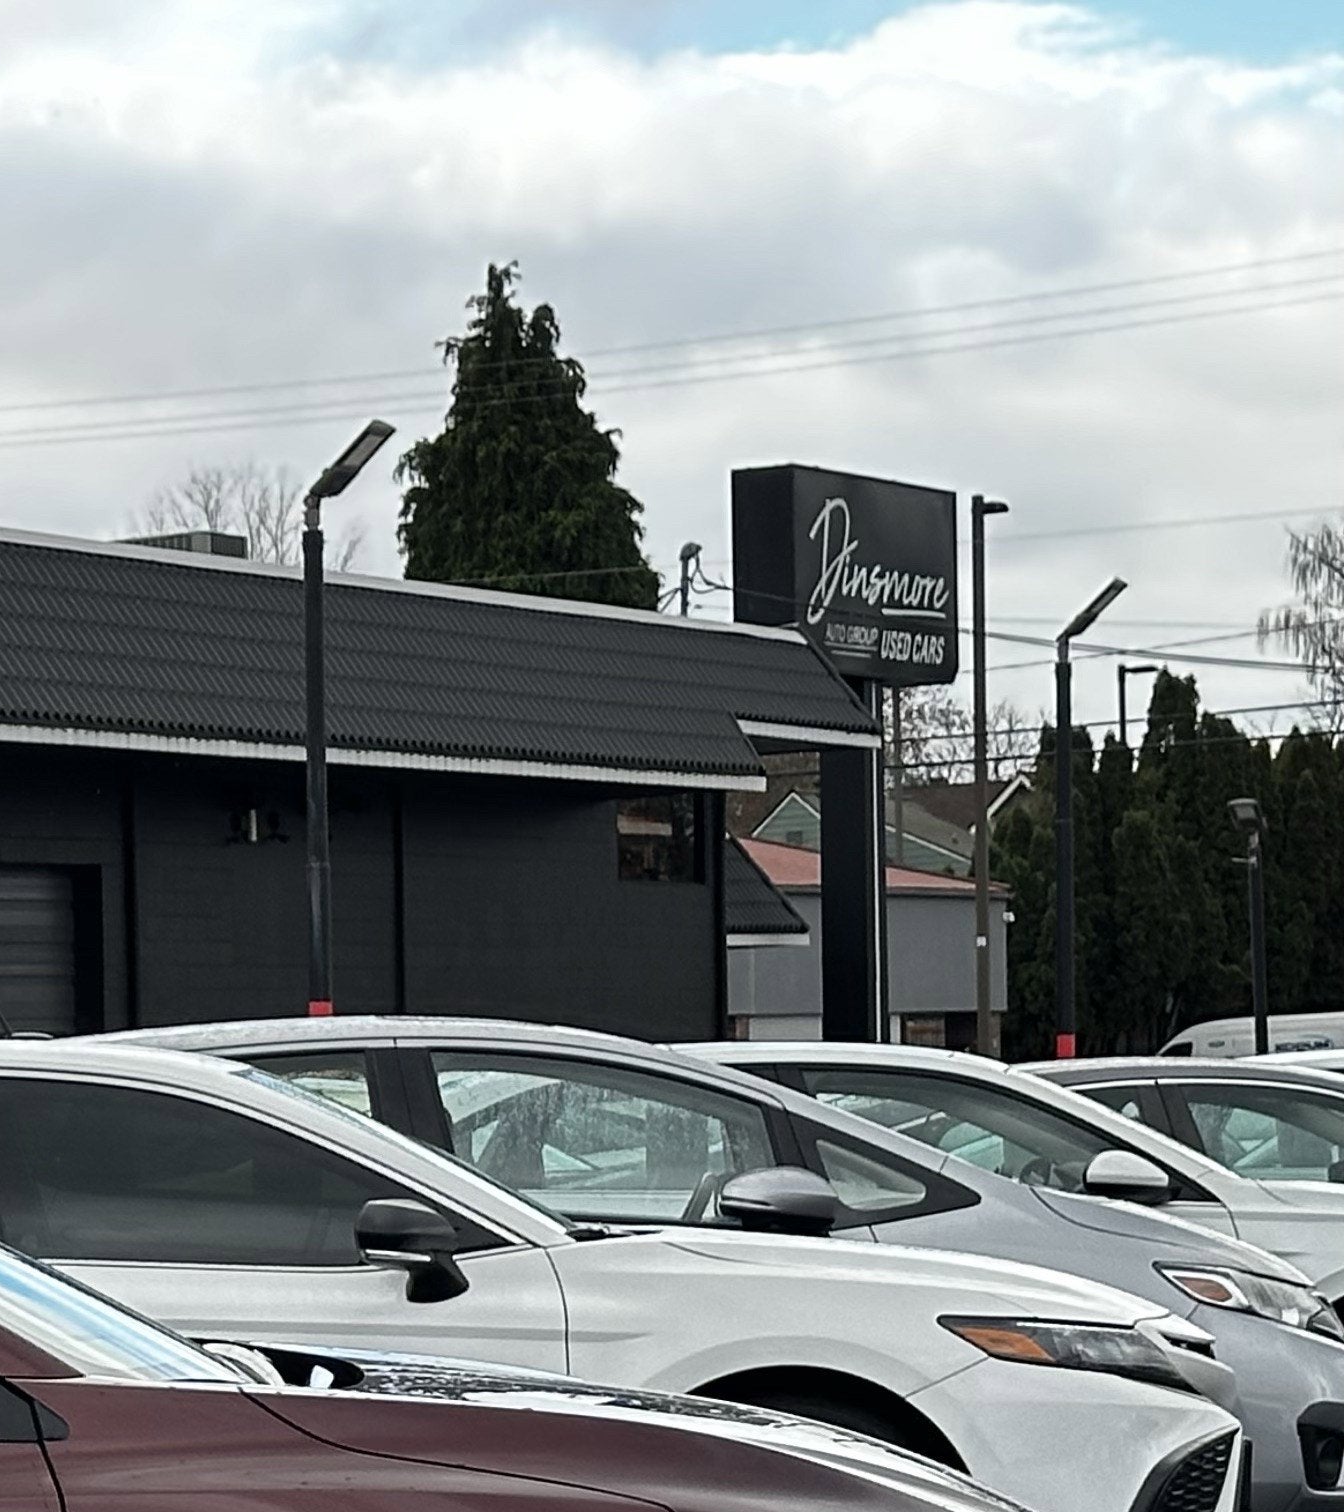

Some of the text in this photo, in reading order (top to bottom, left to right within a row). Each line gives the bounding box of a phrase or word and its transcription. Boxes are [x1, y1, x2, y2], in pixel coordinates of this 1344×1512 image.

[807, 498, 949, 624] Dinsmore
[881, 630, 945, 664] USED CARS
